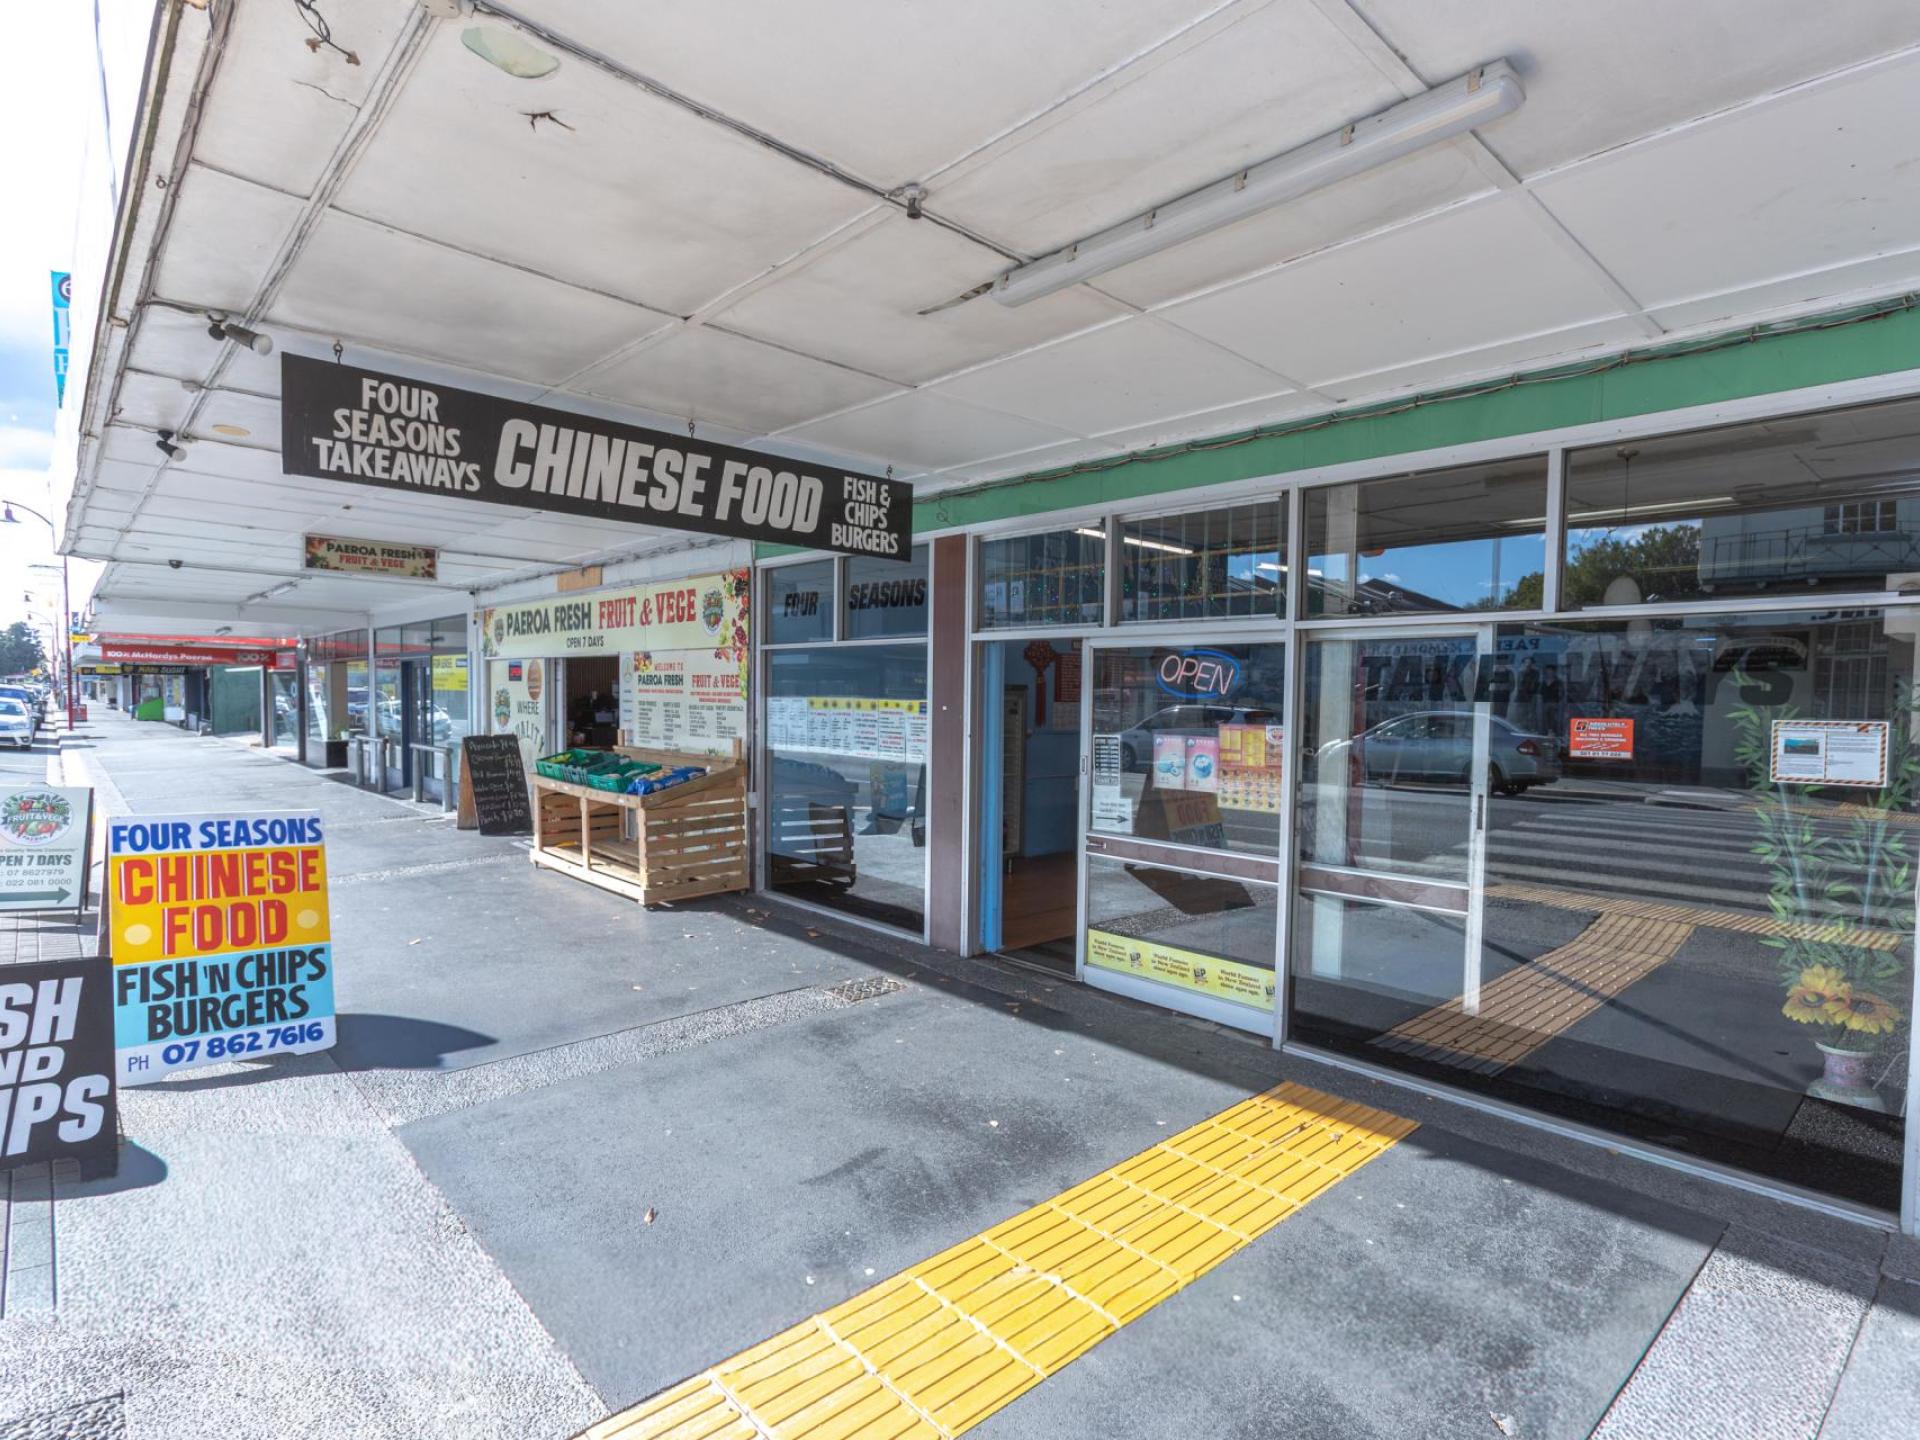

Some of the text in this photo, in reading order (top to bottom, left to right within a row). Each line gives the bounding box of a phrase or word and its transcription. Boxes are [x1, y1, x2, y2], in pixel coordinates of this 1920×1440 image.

[361, 377, 439, 423] FOUR
[333, 407, 461, 458] SEASONS
[312, 437, 480, 492] TAKEAWAYS
[494, 418, 824, 533] CHINESE FOOD
[843, 476, 891, 504] FISH &
[844, 502, 888, 529] CHIPS
[326, 543, 416, 560] PAEROA FRESH
[831, 524, 899, 554] BURGERS
[339, 554, 367, 566] FRUIT
[381, 558, 405, 568] VEGE
[507, 588, 697, 637] PAEROA FRESH FRUIT & VEGE
[783, 578, 927, 617] FOUR SEASONS
[566, 635, 604, 649] OPEN 7 DAYS
[638, 674, 683, 686] PAEROA FRESH
[692, 674, 711, 688] FRUIT
[720, 674, 740, 688] VEGE
[1160, 655, 1234, 695] OPEN
[112, 818, 323, 854] FOUR SEASONS
[26, 855, 34, 867] 7
[37, 855, 72, 866] DAYS
[118, 849, 320, 905] CHINESE
[161, 900, 288, 955] FOOD
[117, 960, 199, 1006] FISH
[235, 947, 326, 989] CHIPS
[0, 977, 83, 1049] SH
[148, 985, 310, 1041] BURGERS
[128, 1022, 324, 1072] PH 07 862 7616
